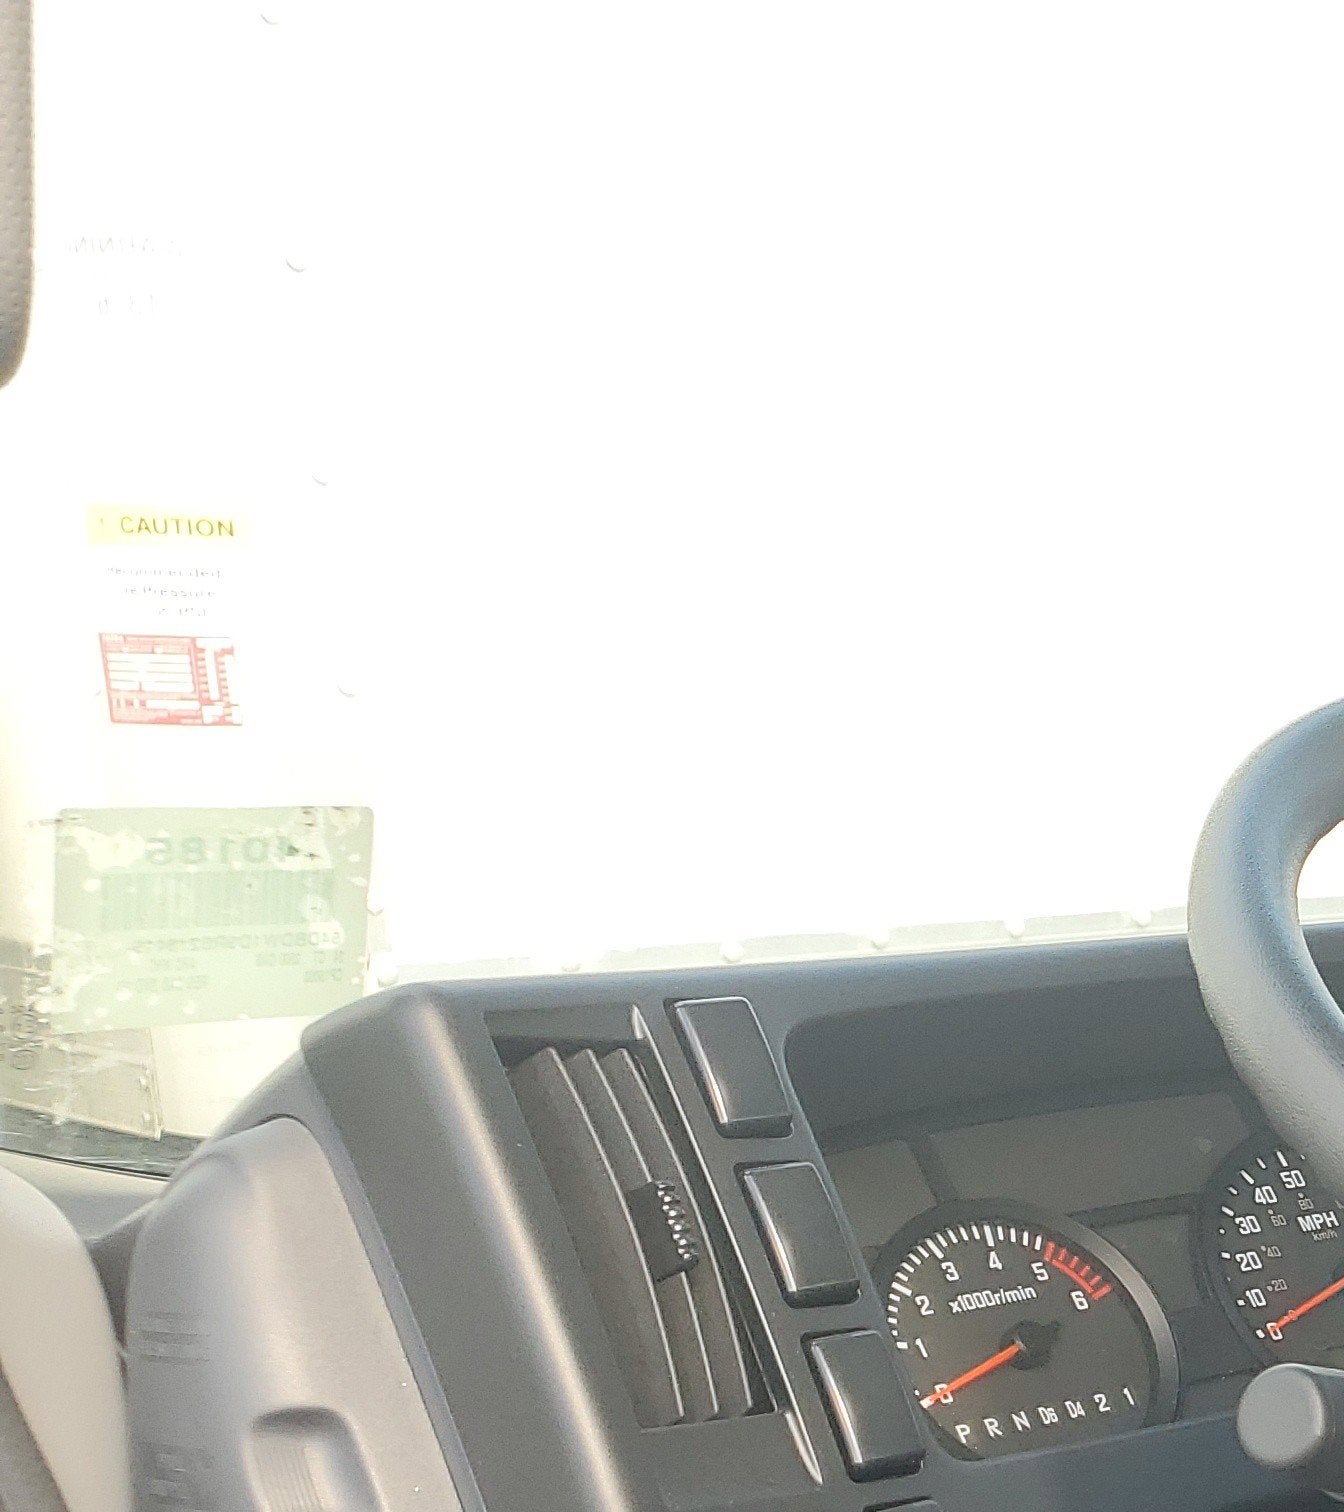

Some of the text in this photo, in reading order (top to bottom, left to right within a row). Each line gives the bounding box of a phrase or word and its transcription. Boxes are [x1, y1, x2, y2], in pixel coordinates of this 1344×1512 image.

[120, 516, 235, 537] CAUTION
[1280, 1170, 1305, 1189] 50
[1254, 1186, 1278, 1205] 40
[1298, 1198, 1313, 1210] 80
[1235, 1216, 1260, 1235] 30
[1270, 1214, 1287, 1226] 60
[1296, 1211, 1339, 1233] MPH
[1312, 1230, 1338, 1241] km/h
[988, 1251, 1003, 1271] 4
[1235, 1251, 1262, 1272] 20
[1266, 1246, 1281, 1258] 40
[941, 1261, 960, 1282] 3
[1031, 1261, 1049, 1282] 5
[1274, 1279, 1287, 1291] 20
[916, 1294, 934, 1316] 2
[1070, 1290, 1089, 1311] 6
[1245, 1288, 1267, 1308] 10
[916, 1338, 928, 1359] 1
[955, 1424, 972, 1443] P
[983, 1418, 1003, 1438] R
[1012, 1411, 1031, 1431] N
[1094, 1393, 1111, 1413] 2
[1123, 1387, 1135, 1406] 1
